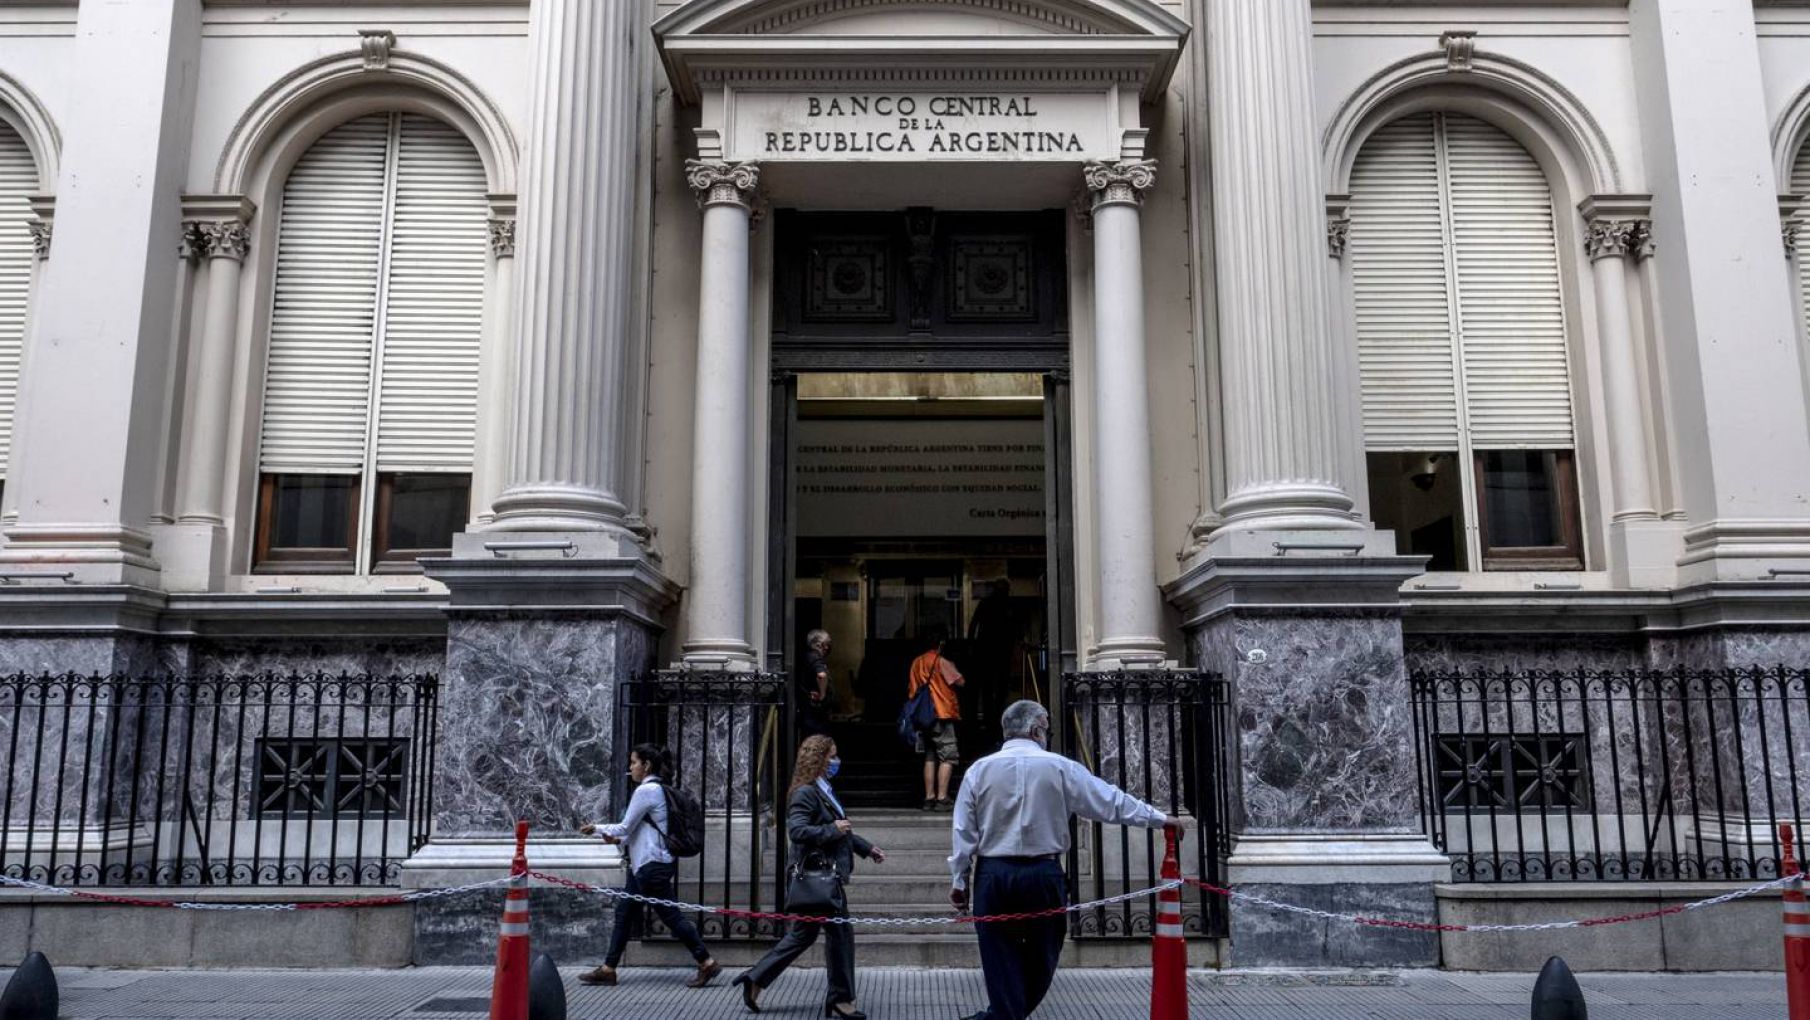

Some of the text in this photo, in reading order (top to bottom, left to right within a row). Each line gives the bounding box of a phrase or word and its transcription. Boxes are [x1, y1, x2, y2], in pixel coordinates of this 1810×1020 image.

[807, 96, 1038, 117] BANCO CENTRAL
[899, 117, 945, 130] DE LA
[765, 131, 1084, 152] REPUBLICA ARGENTINA
[922, 445, 975, 453] ARGENTINA
[969, 508, 995, 518] Carta
